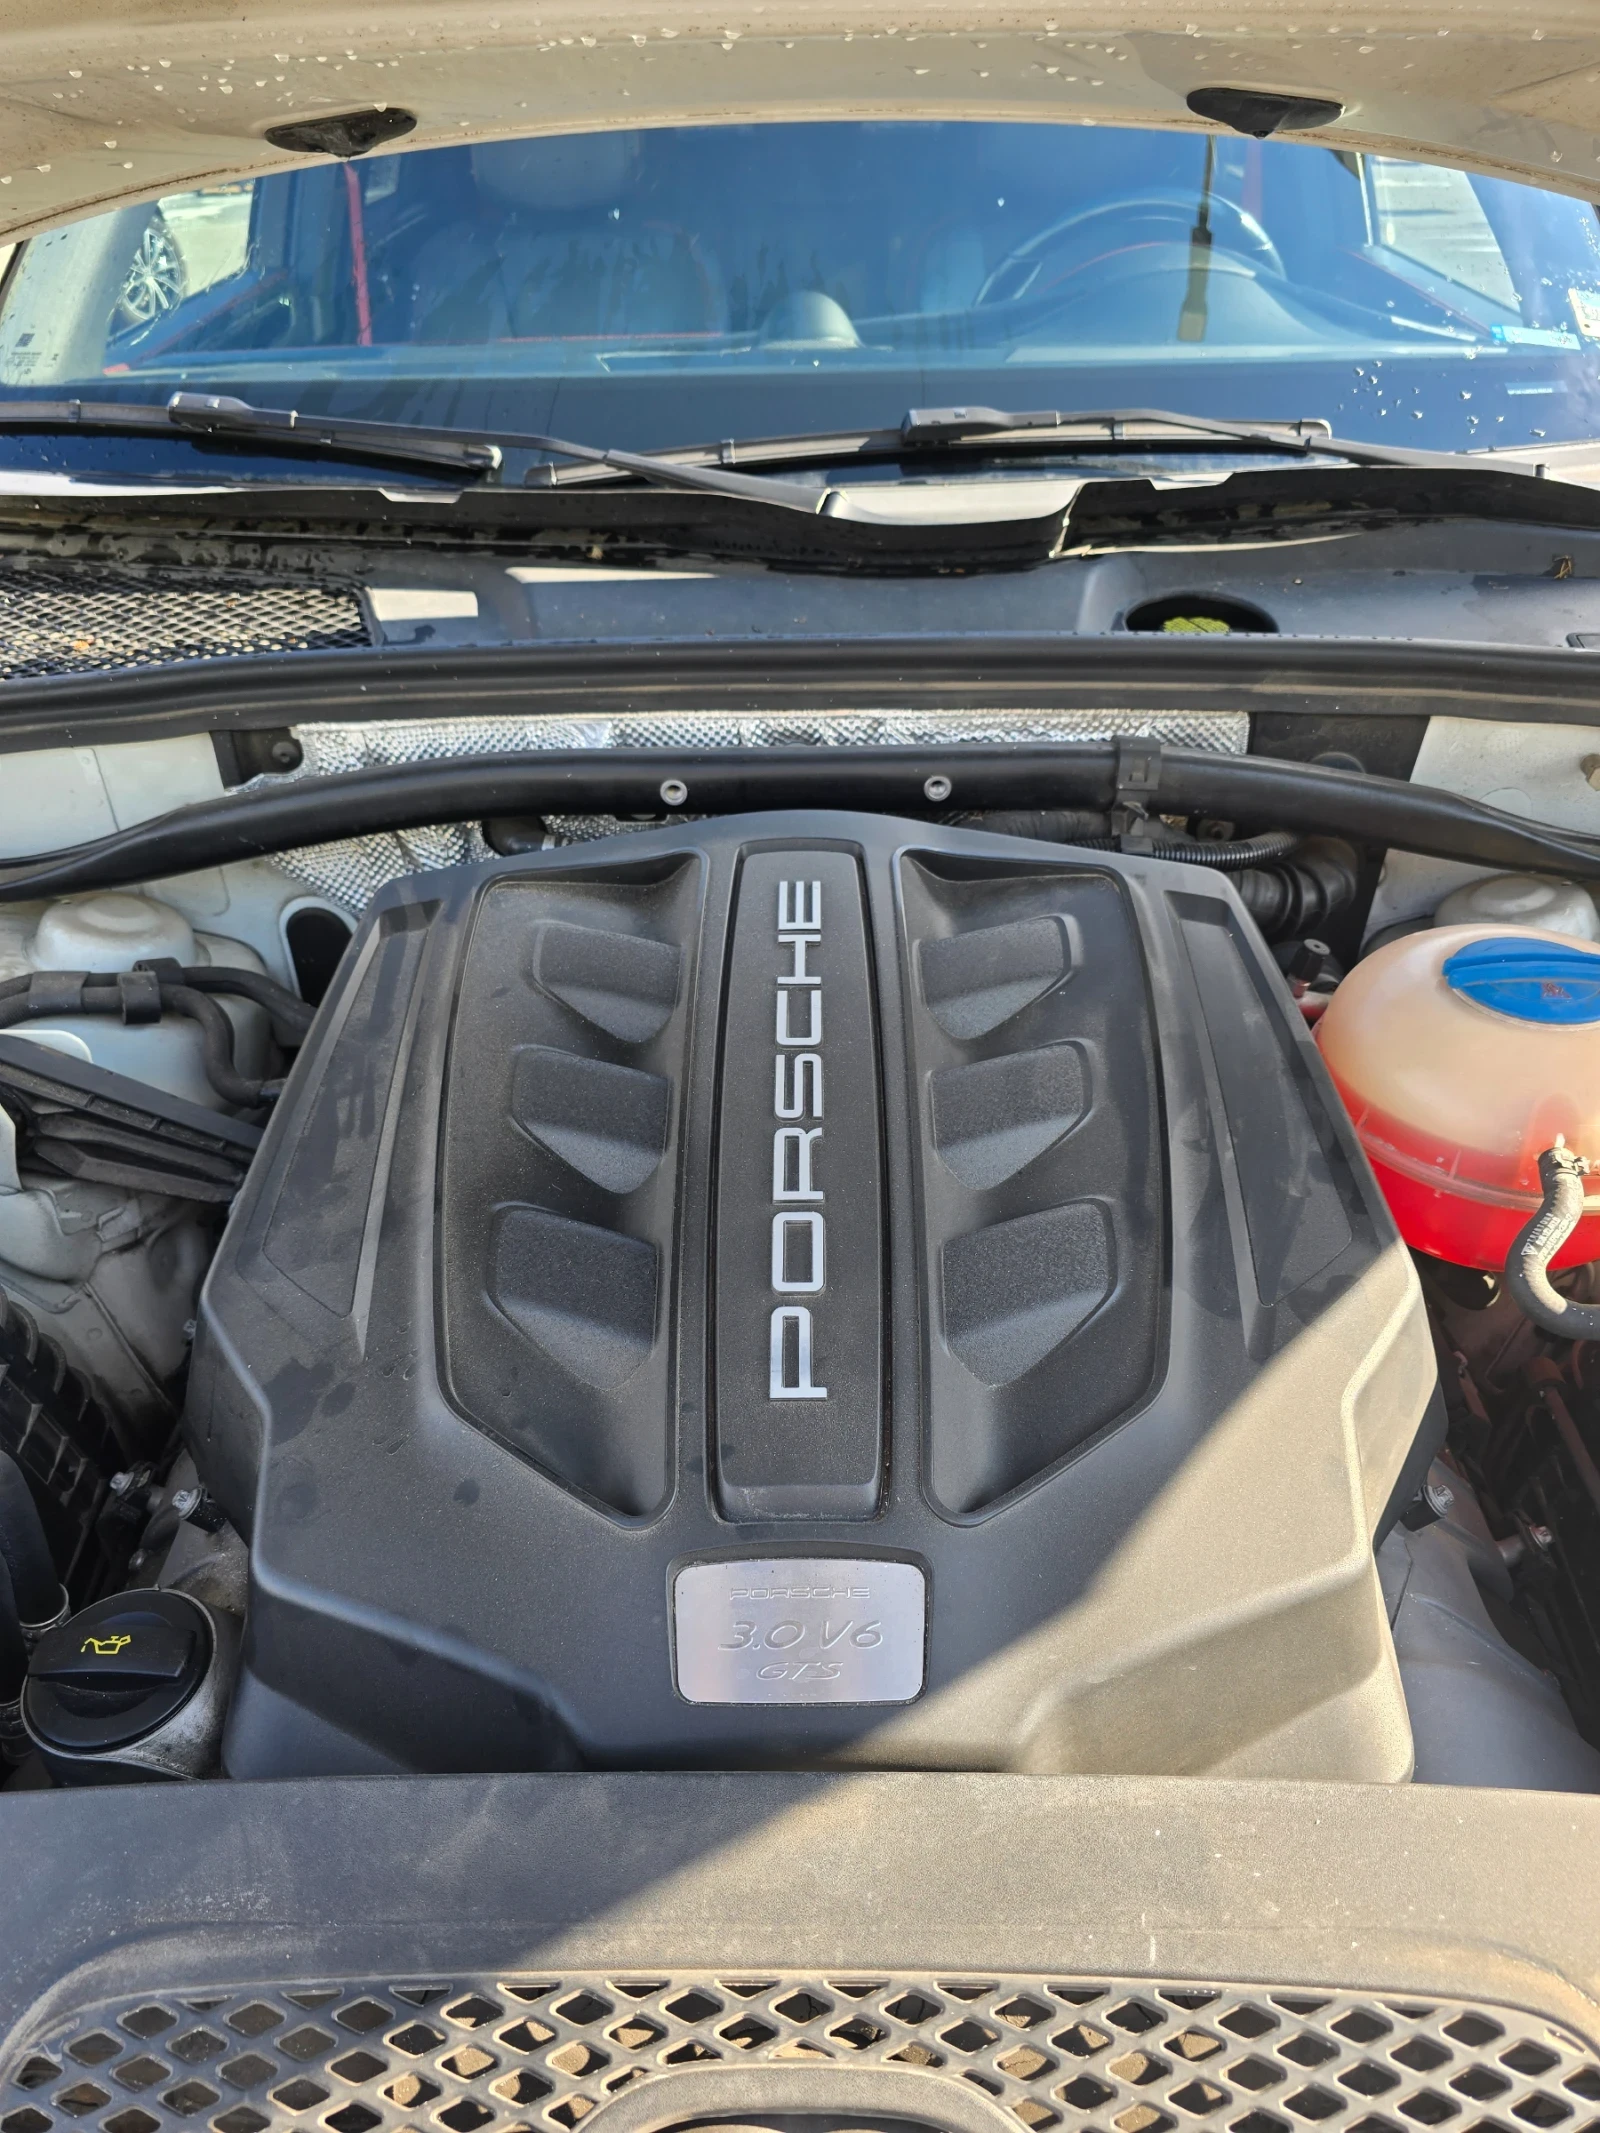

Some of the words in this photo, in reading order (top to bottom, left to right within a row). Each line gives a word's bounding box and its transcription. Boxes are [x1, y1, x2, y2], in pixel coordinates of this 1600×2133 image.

[769, 881, 828, 1399] PORSCHE
[730, 1587, 870, 1600] PORSCHE
[718, 1620, 806, 1650] 3.0
[820, 1620, 883, 1650] V6
[756, 1662, 844, 1680] GTS
